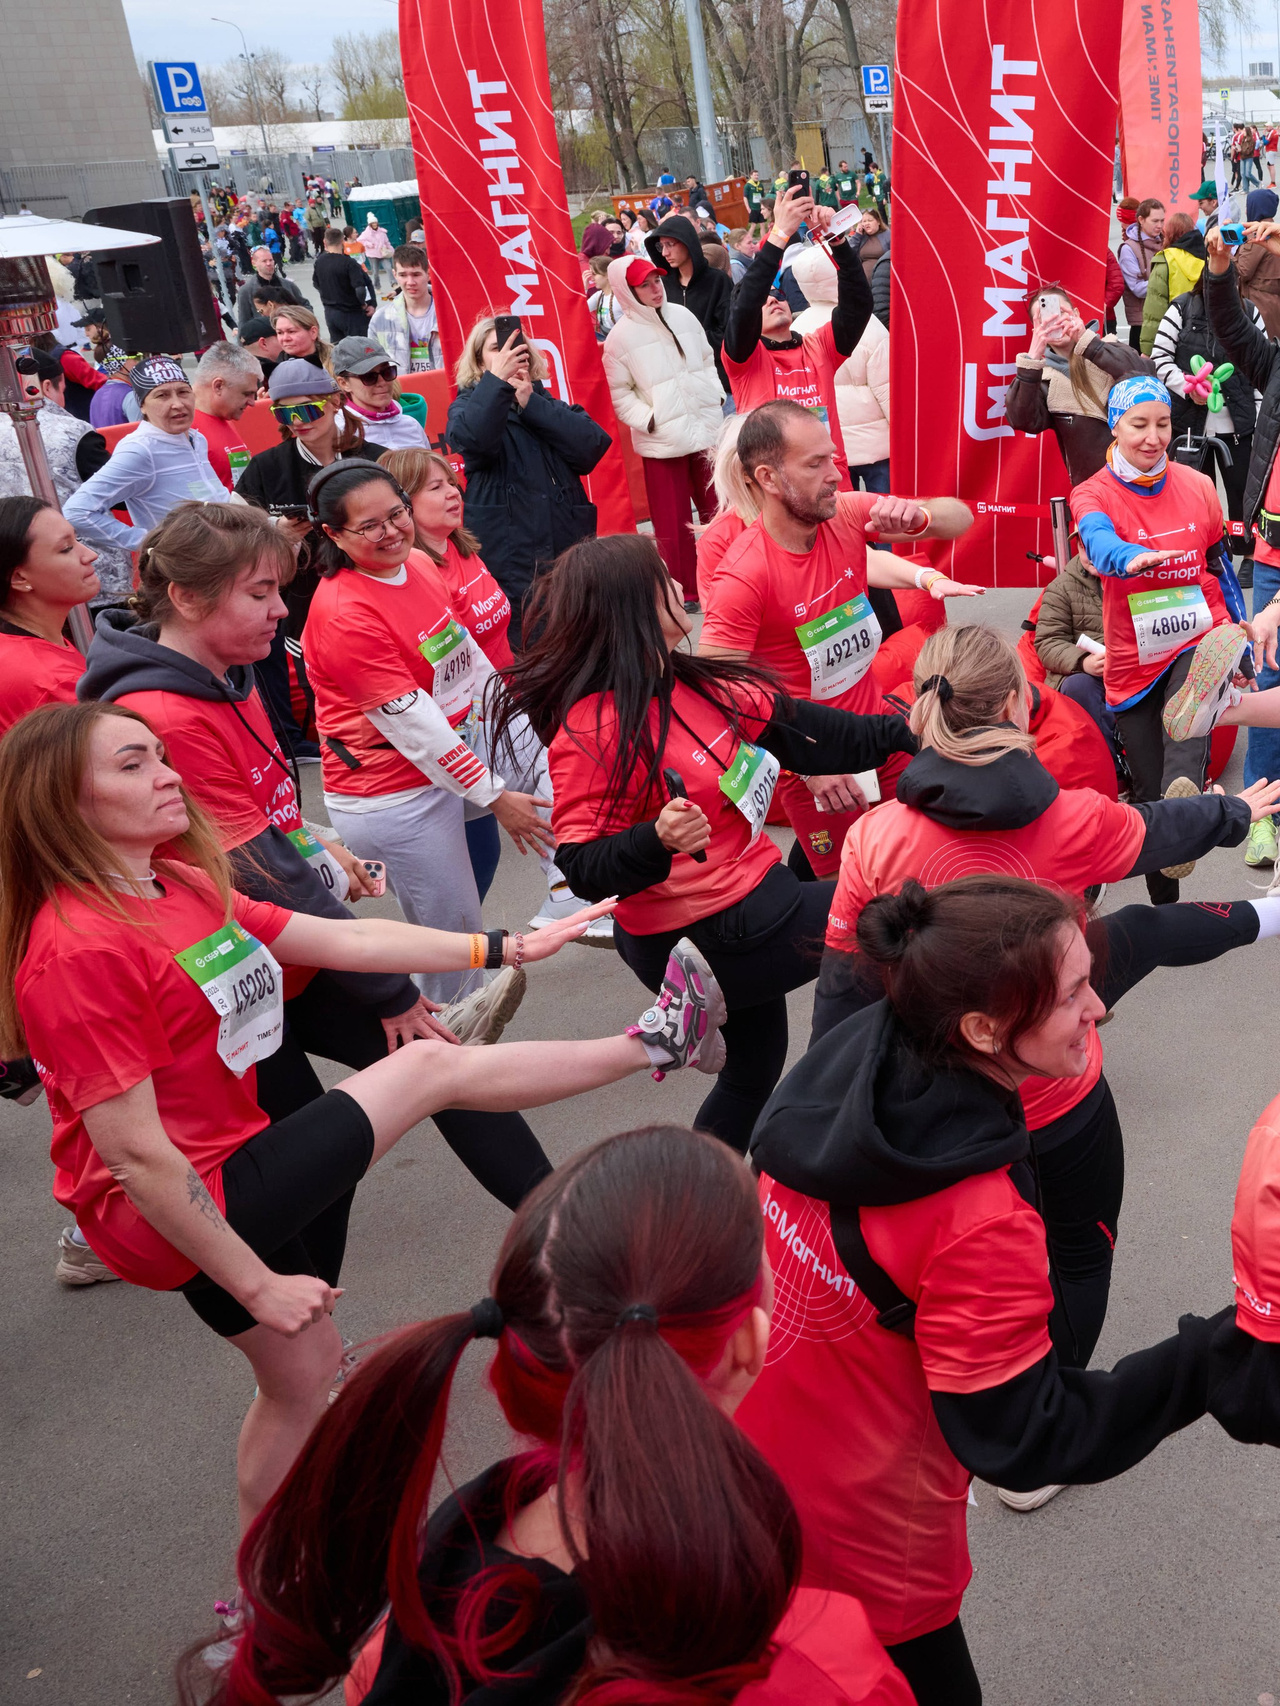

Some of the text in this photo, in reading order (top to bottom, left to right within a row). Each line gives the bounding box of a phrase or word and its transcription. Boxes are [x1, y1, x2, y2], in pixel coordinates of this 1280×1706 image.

[467, 69, 544, 316] МАГНИТ
[982, 44, 1038, 336] МАГНИТ
[144, 362, 183, 377] HARD
[152, 370, 185, 384] RUN
[988, 504, 1017, 514] МАГНИТ
[1157, 565, 1202, 581] спорт
[476, 621, 494, 635] за
[1152, 612, 1198, 637] 48067
[826, 628, 871, 667] 49218
[444, 648, 471, 683] 49196
[232, 962, 276, 1017] 49203
[776, 1210, 856, 1297] Магнит
